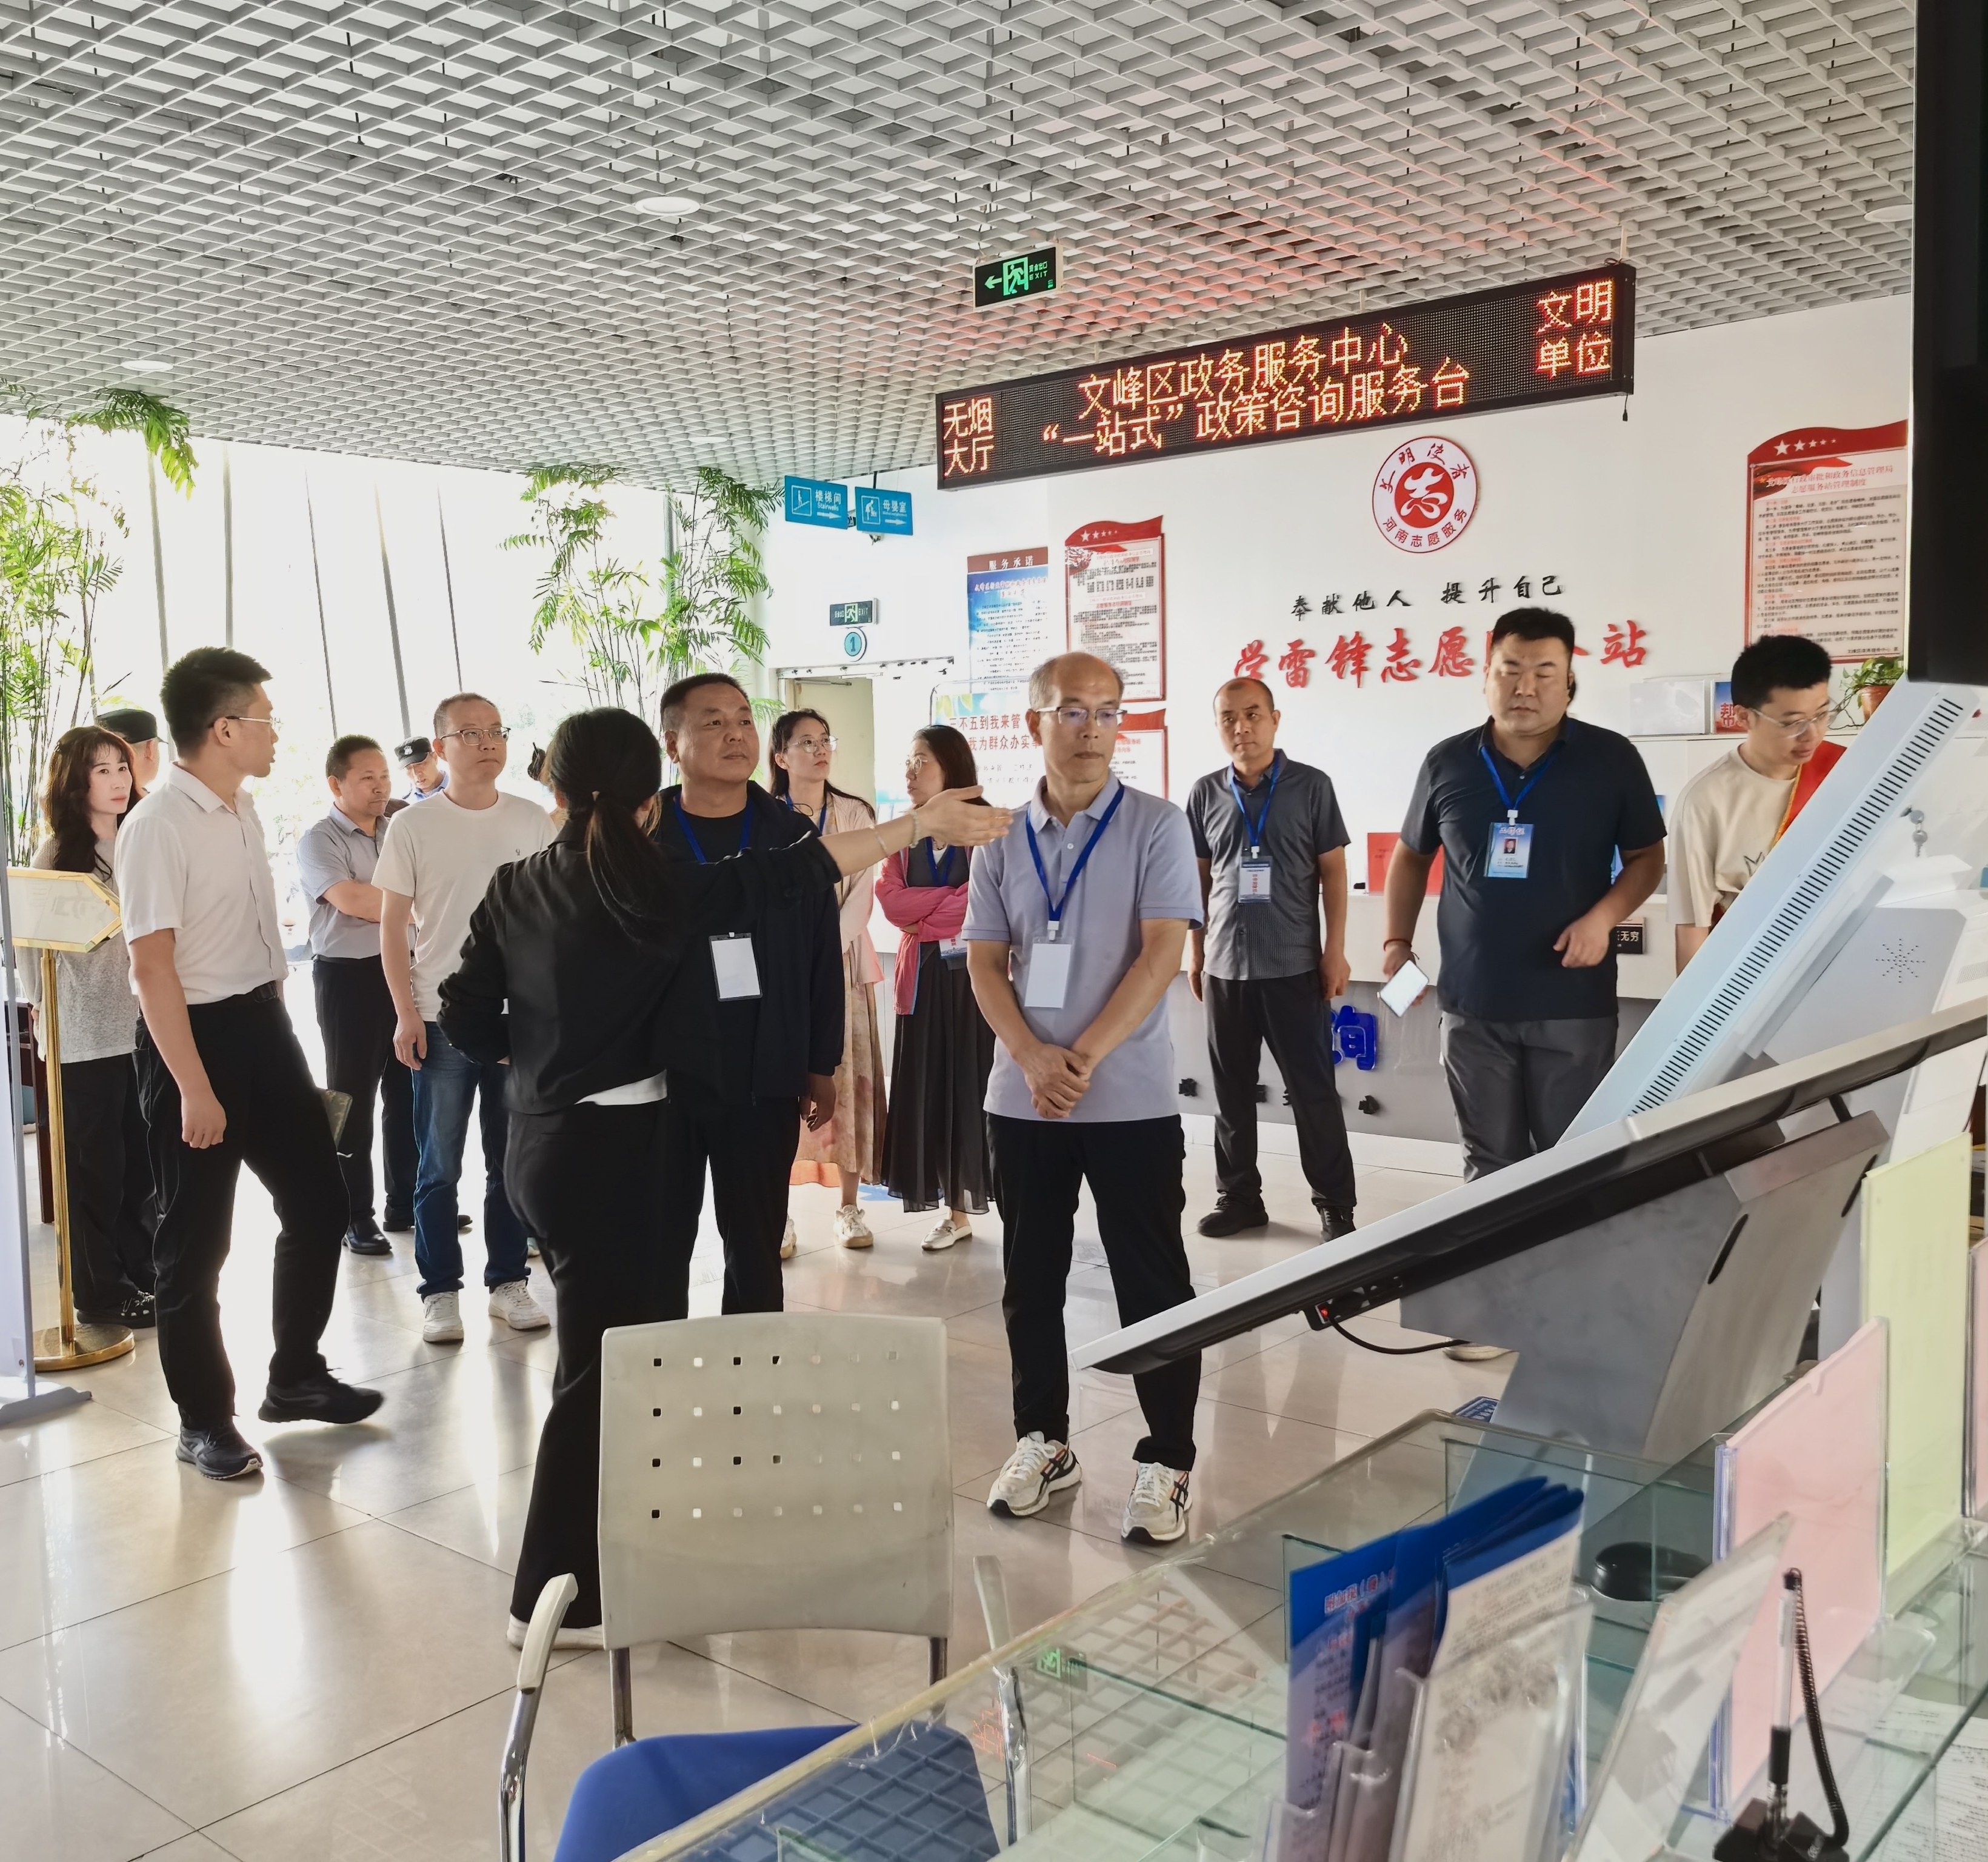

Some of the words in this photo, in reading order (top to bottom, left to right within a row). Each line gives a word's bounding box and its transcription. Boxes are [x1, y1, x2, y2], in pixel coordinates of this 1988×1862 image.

[1029, 270, 1048, 281] EXIT
[1537, 279, 1612, 333] 文明
[1078, 322, 1409, 421] 文峰区政务服务中心
[1536, 330, 1612, 377] 单位
[943, 397, 993, 439] 无烟
[944, 435, 995, 477] 大厅
[815, 489, 841, 504] 楼梯间
[882, 499, 907, 513] 母婴室
[1383, 509, 1467, 547] 河南志愿服务
[989, 555, 1034, 570] 服务承诺
[1290, 590, 1411, 621] 奉献他人
[1440, 575, 1562, 604] 提升自己
[850, 636, 856, 652] 1
[1233, 620, 1647, 689] 学雷锋志愿站
[1616, 930, 1639, 942] 无穷
